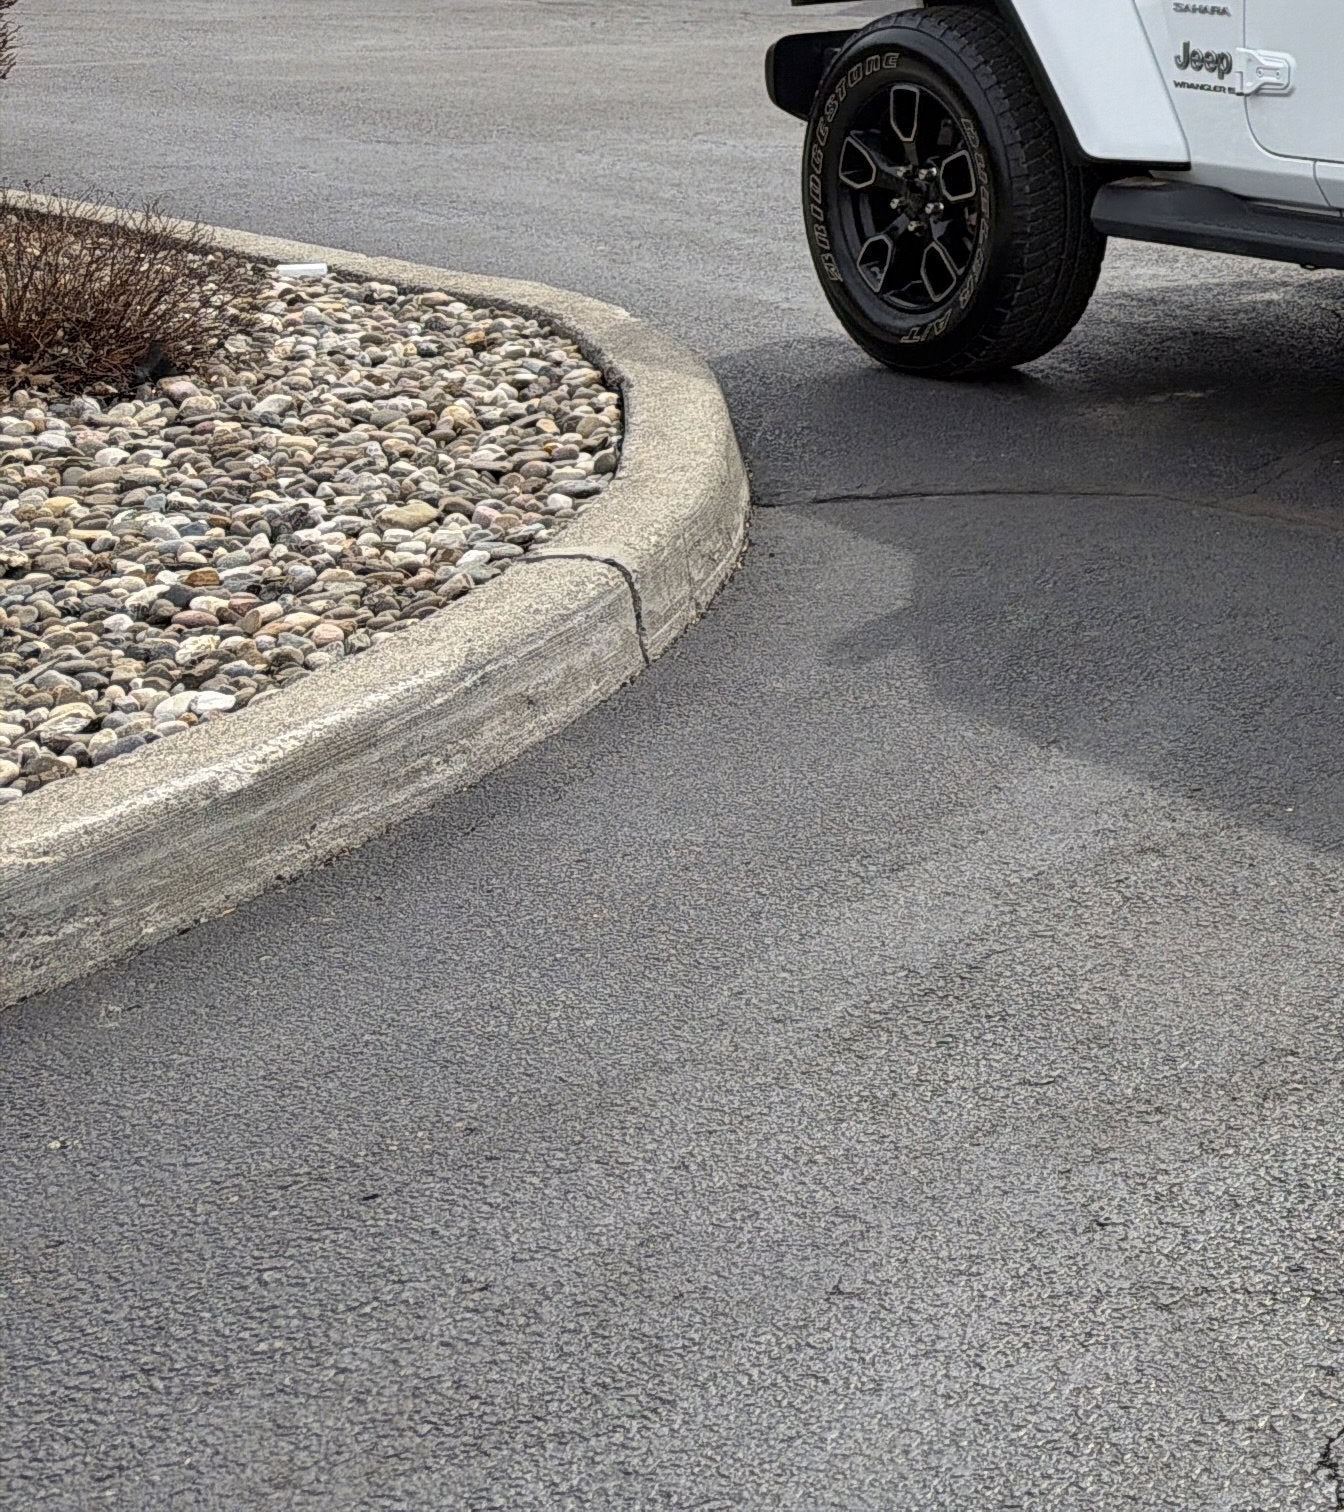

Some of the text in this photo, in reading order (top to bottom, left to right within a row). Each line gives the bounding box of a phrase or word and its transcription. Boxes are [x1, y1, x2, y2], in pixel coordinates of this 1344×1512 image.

[1173, 2, 1231, 17] SAHARA
[1174, 41, 1233, 80] Jeep
[1173, 80, 1226, 93] WRANGLER
[809, 53, 900, 282] BRIDGESTONE
